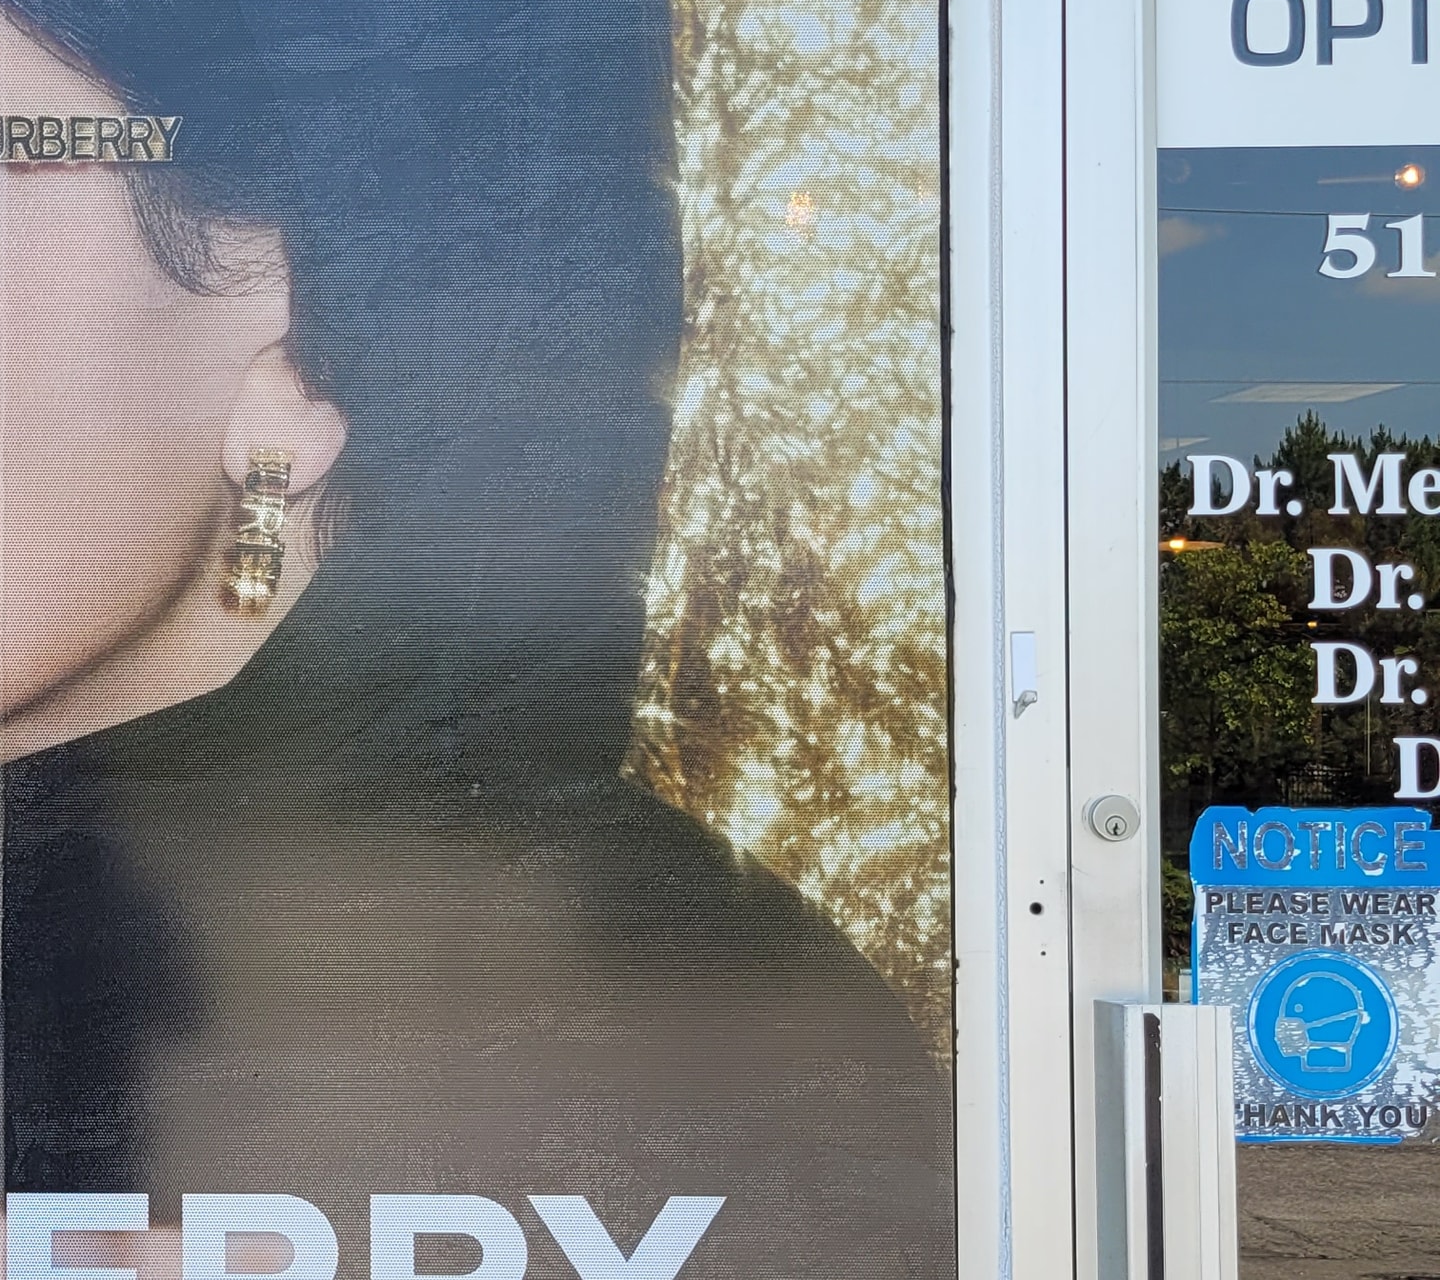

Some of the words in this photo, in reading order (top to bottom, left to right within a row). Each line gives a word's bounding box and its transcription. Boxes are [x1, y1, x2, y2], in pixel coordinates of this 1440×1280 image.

[1318, 213, 1437, 279] 51
[1186, 454, 1303, 517] Dr.
[1326, 452, 1440, 516] Me
[1306, 547, 1423, 610] Dr.
[1310, 642, 1428, 705] Dr.
[1211, 821, 1428, 871] NOTICE
[1206, 891, 1330, 915] PLEASE
[1340, 892, 1437, 916] WEAR
[1227, 922, 1309, 945] FACE
[1320, 922, 1416, 946] MASK
[1355, 1104, 1428, 1129] YOU
